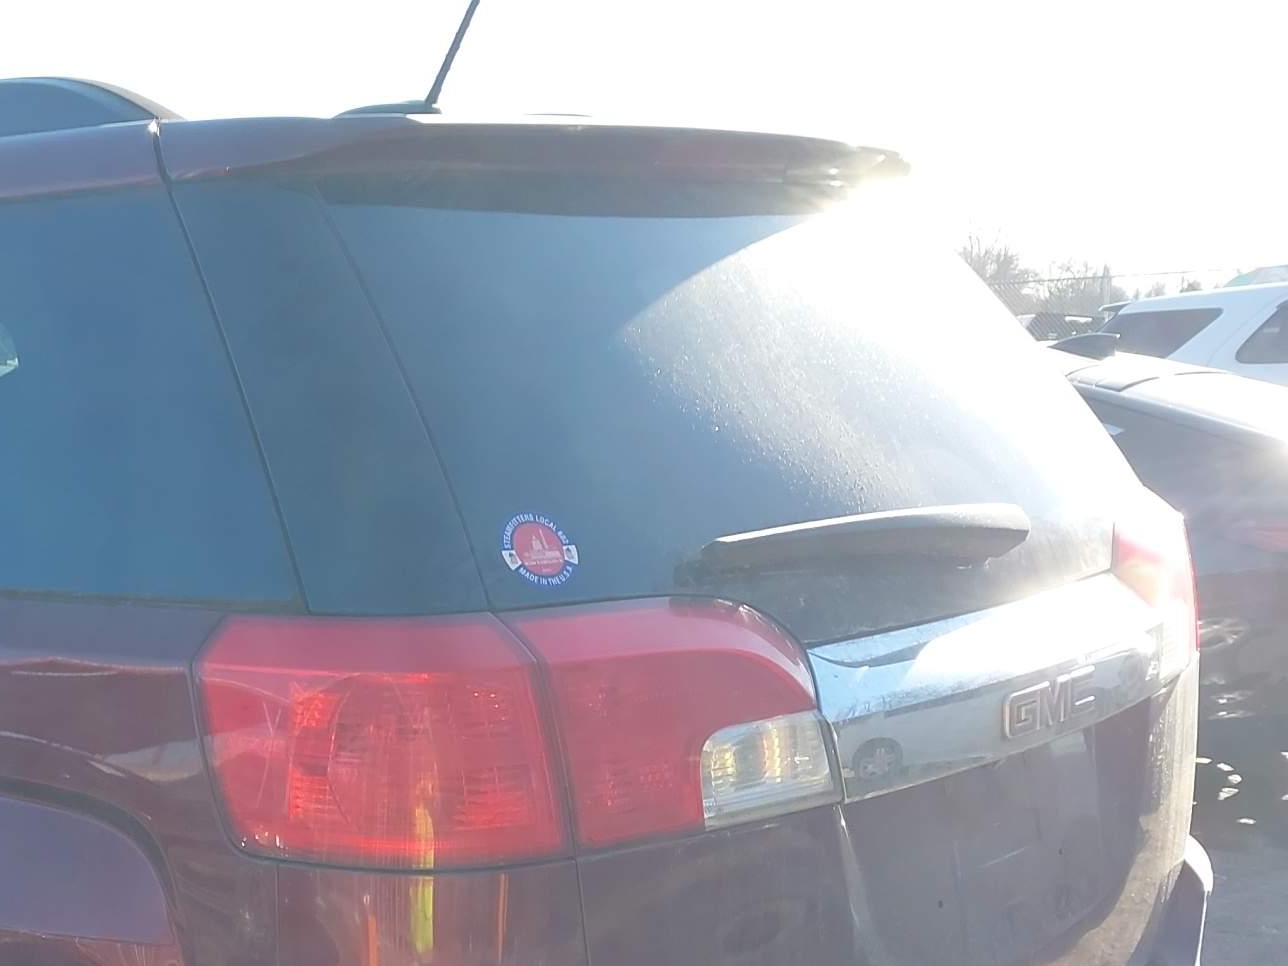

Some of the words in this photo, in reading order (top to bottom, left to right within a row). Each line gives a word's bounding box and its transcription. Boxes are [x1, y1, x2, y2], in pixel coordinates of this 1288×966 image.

[535, 514, 557, 532] LOCAL
[518, 567, 538, 584] MADE
[548, 577, 562, 586] THE
[1002, 664, 1096, 738] GMC
